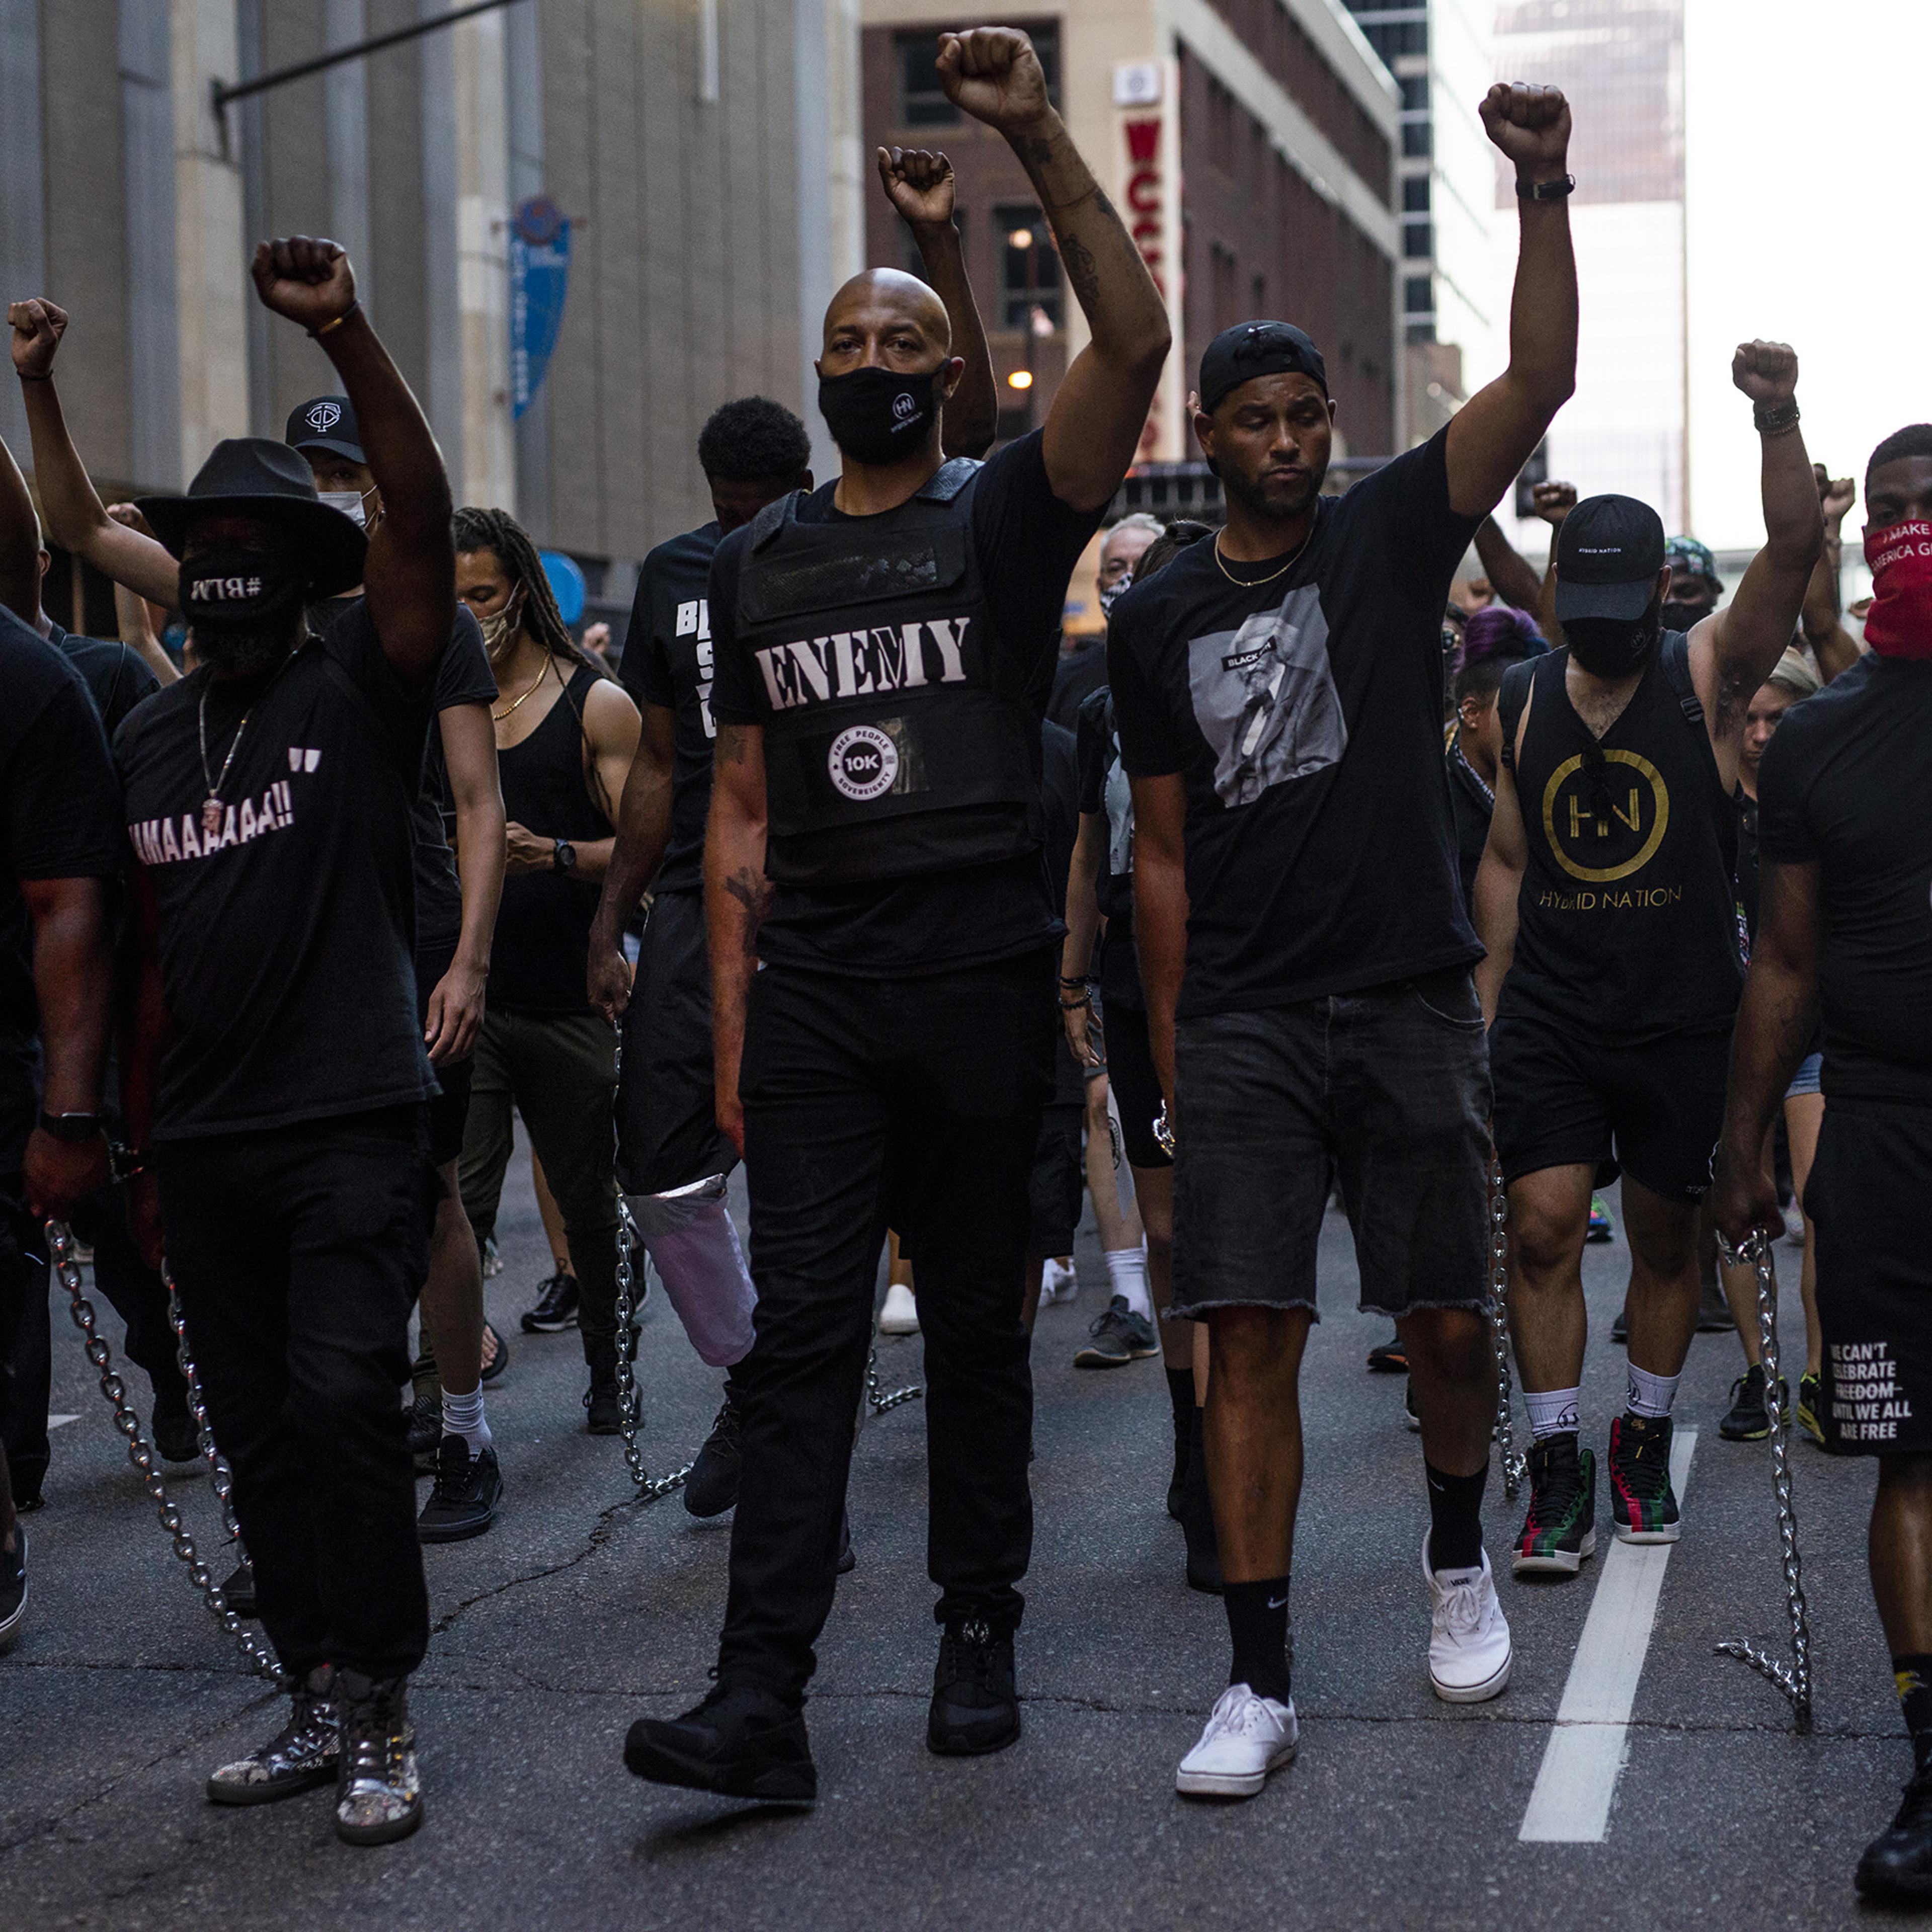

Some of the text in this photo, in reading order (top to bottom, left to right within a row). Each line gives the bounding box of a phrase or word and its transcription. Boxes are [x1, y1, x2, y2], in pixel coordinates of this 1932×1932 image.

[1889, 524, 1930, 541] MAKE
[755, 617, 971, 710] ENEMY
[834, 730, 890, 756] FREE PEOPLE
[845, 754, 879, 772] 10K
[838, 771, 891, 795] SOVEREIGNTY
[1602, 885, 1682, 909] NATION
[1842, 1342, 1887, 1361] CAN'T
[1855, 1402, 1880, 1420] WE
[1882, 1400, 1912, 1419] ALL
[1860, 1421, 1897, 1440] FREE
